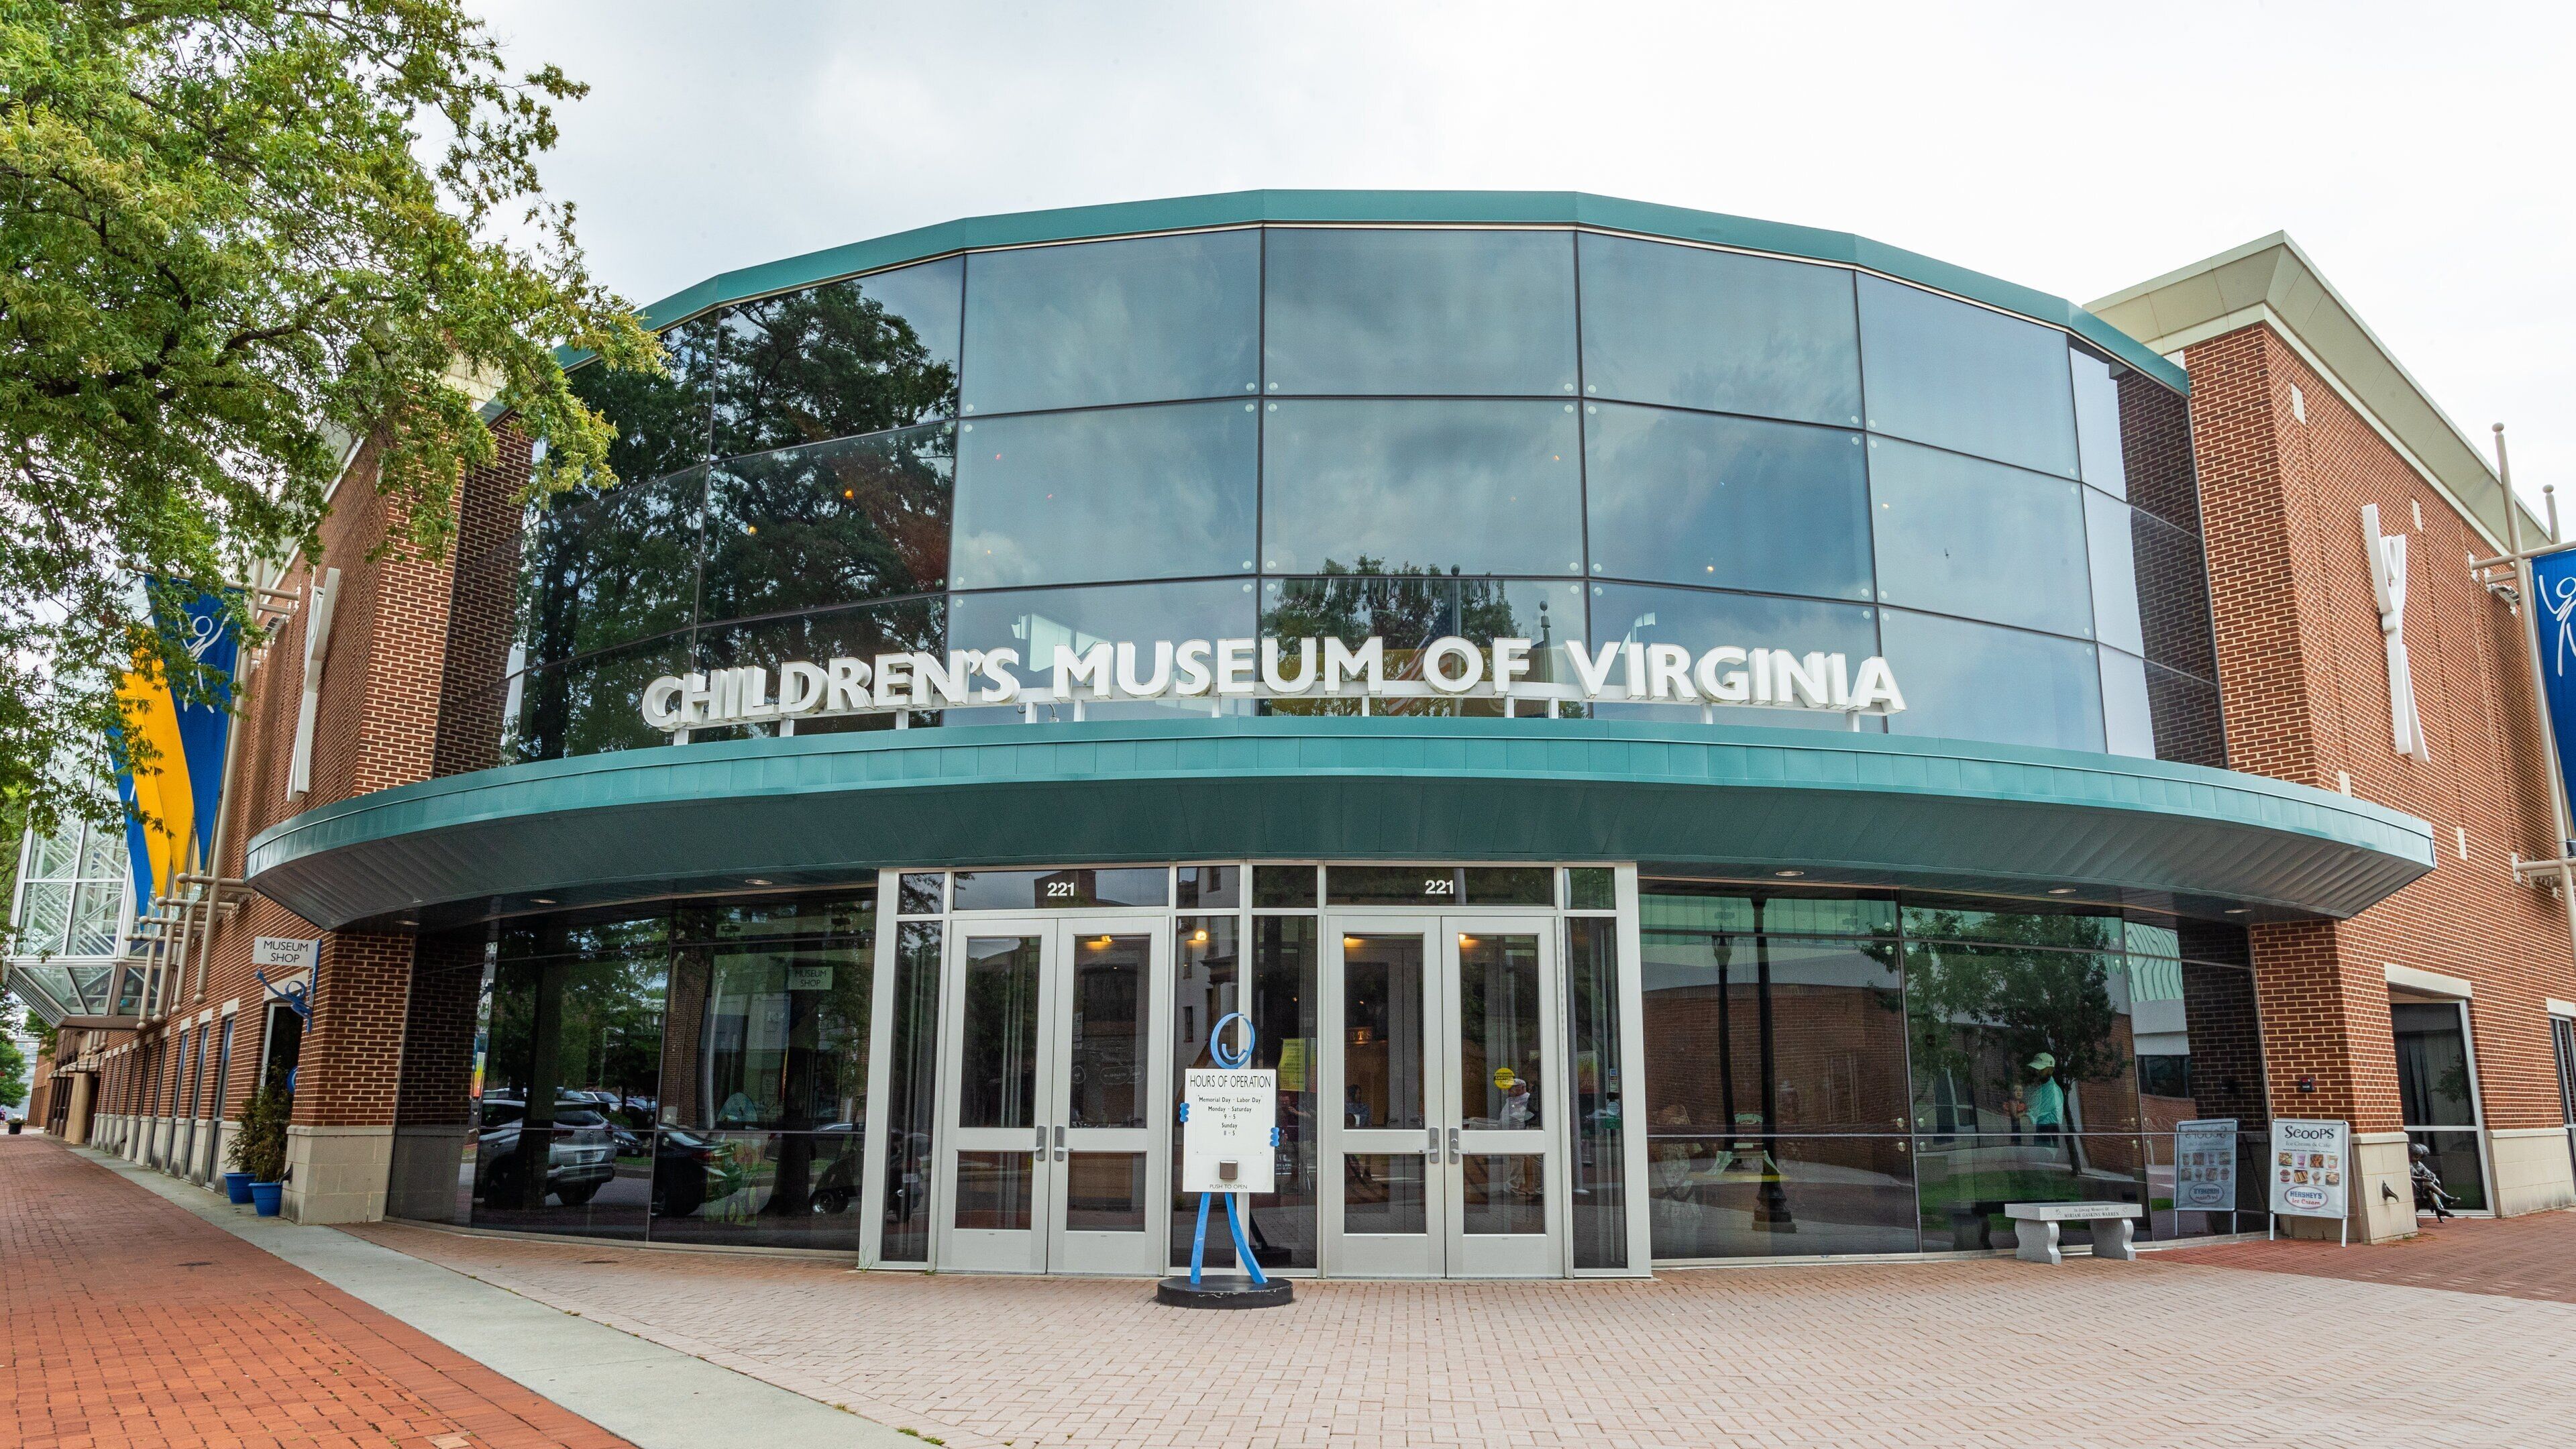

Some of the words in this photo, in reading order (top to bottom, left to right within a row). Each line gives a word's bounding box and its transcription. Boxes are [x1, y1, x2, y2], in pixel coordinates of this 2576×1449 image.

[642, 647, 1020, 731] CHILDREN'S
[1053, 636, 1383, 702] MUSEUM
[1422, 635, 1532, 696] OF
[1564, 640, 1907, 715] VIRGINIA
[1047, 881, 1075, 897] 221
[1425, 879, 1454, 894] 221
[263, 940, 309, 953] MUSEUM
[270, 952, 301, 963] SHOP
[795, 969, 826, 977] MUSEUM
[1189, 1075, 1216, 1087] HOURS
[1218, 1075, 1228, 1087] OF
[1230, 1075, 1271, 1088] OPERATION
[2290, 1191, 2322, 1199] HERSHEY'S
